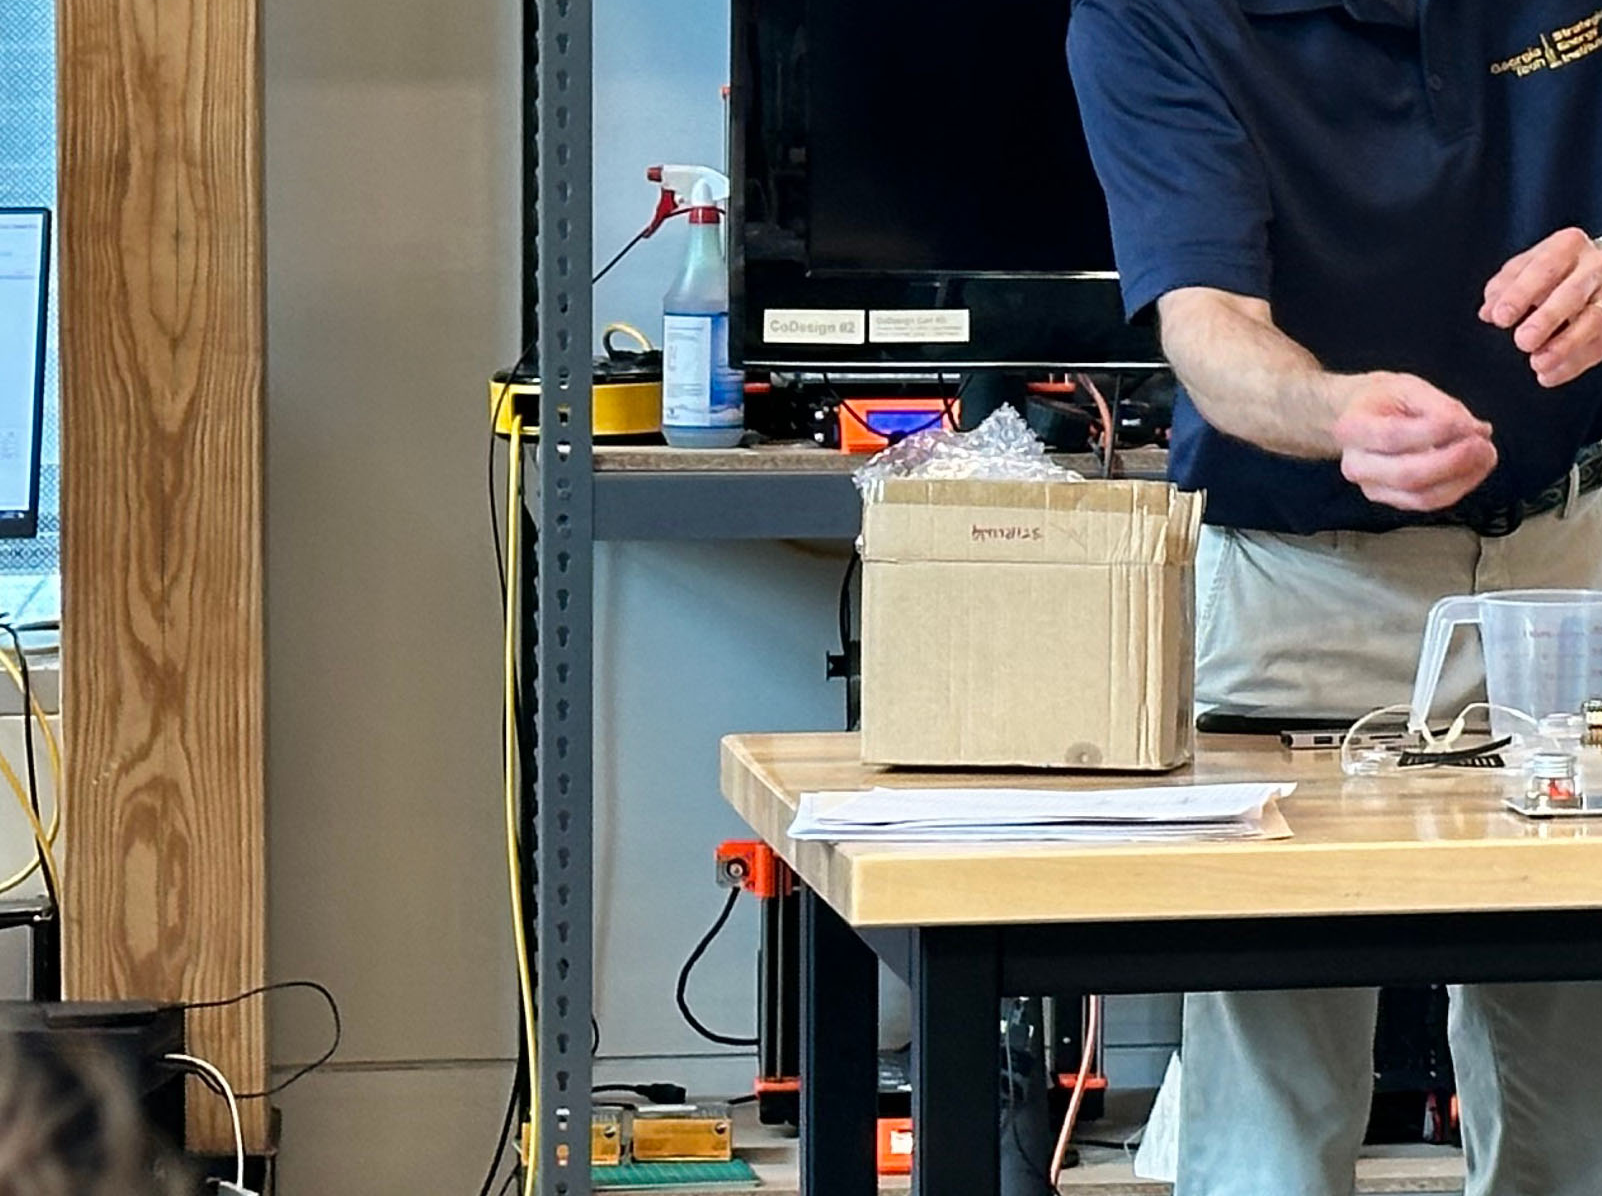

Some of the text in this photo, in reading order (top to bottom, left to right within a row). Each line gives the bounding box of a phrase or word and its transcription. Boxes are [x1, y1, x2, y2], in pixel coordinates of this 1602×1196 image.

[1556, 26, 1598, 51] Energy
[1490, 47, 1542, 75] Georgia
[1516, 58, 1547, 77] Tech
[770, 319, 836, 335] CoDesign
